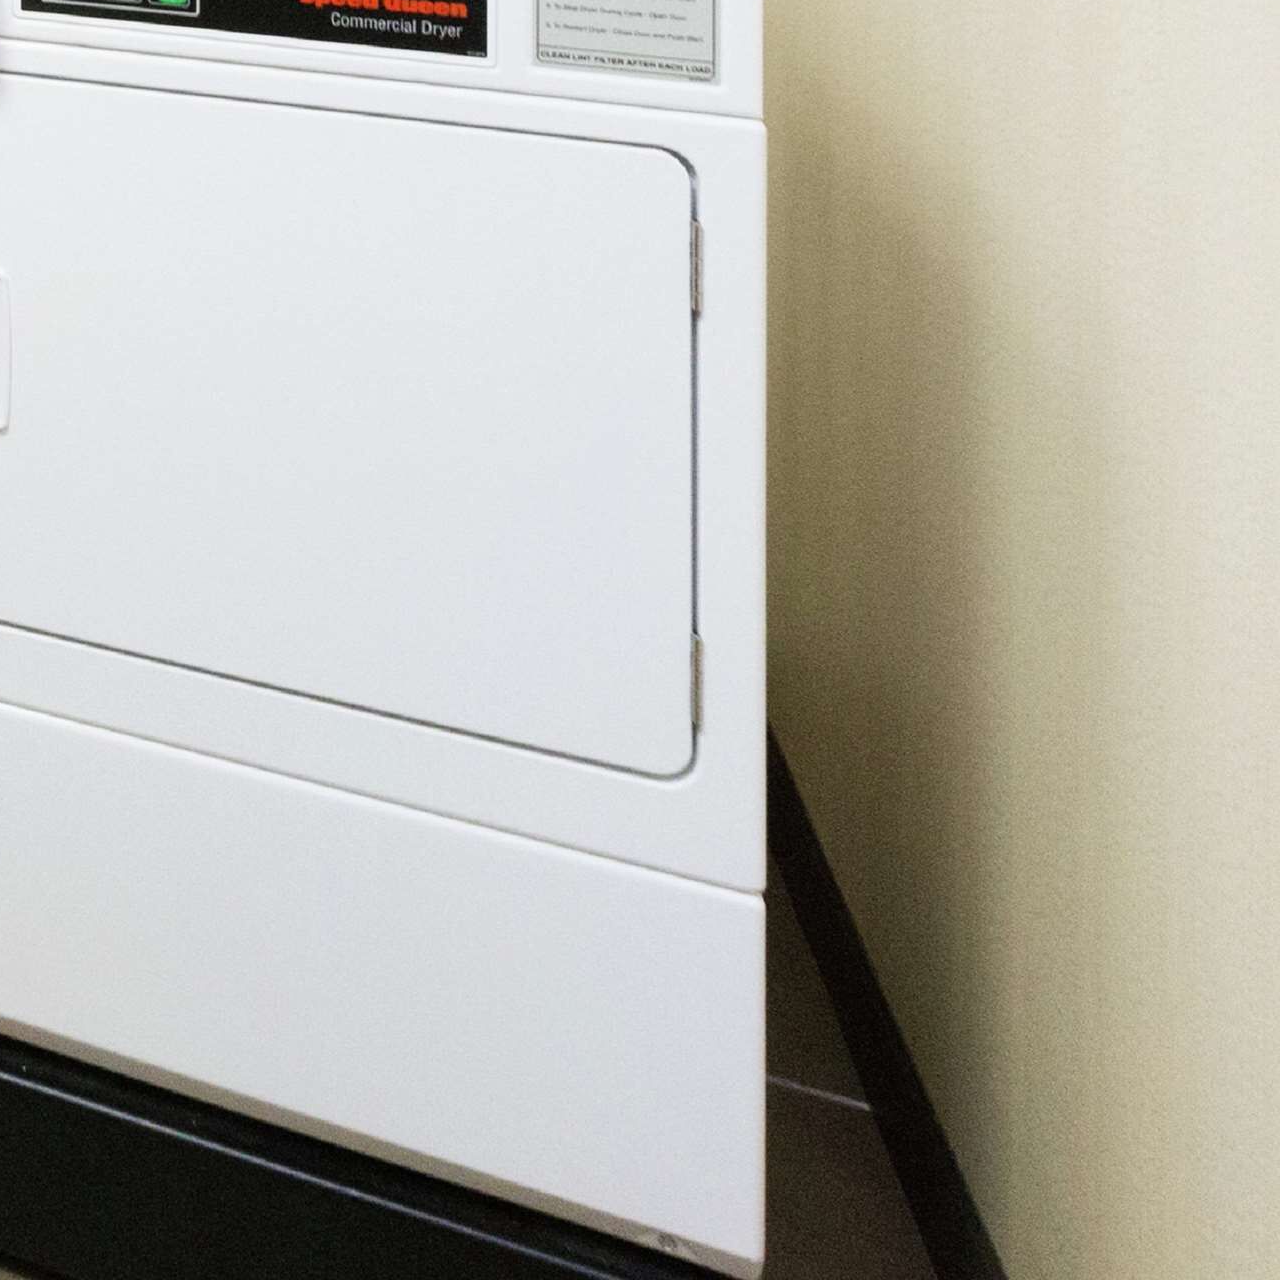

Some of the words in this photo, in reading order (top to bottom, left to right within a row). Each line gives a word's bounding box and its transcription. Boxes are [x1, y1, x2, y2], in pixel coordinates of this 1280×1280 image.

[331, 11, 416, 33] Commercial
[421, 21, 463, 40] Dryer
[541, 51, 570, 60] CLEAN
[572, 54, 590, 62] LINT
[593, 56, 625, 66] FILTER
[626, 59, 656, 68] AFTER
[658, 61, 684, 72] EACH
[686, 64, 711, 74] LOAD
